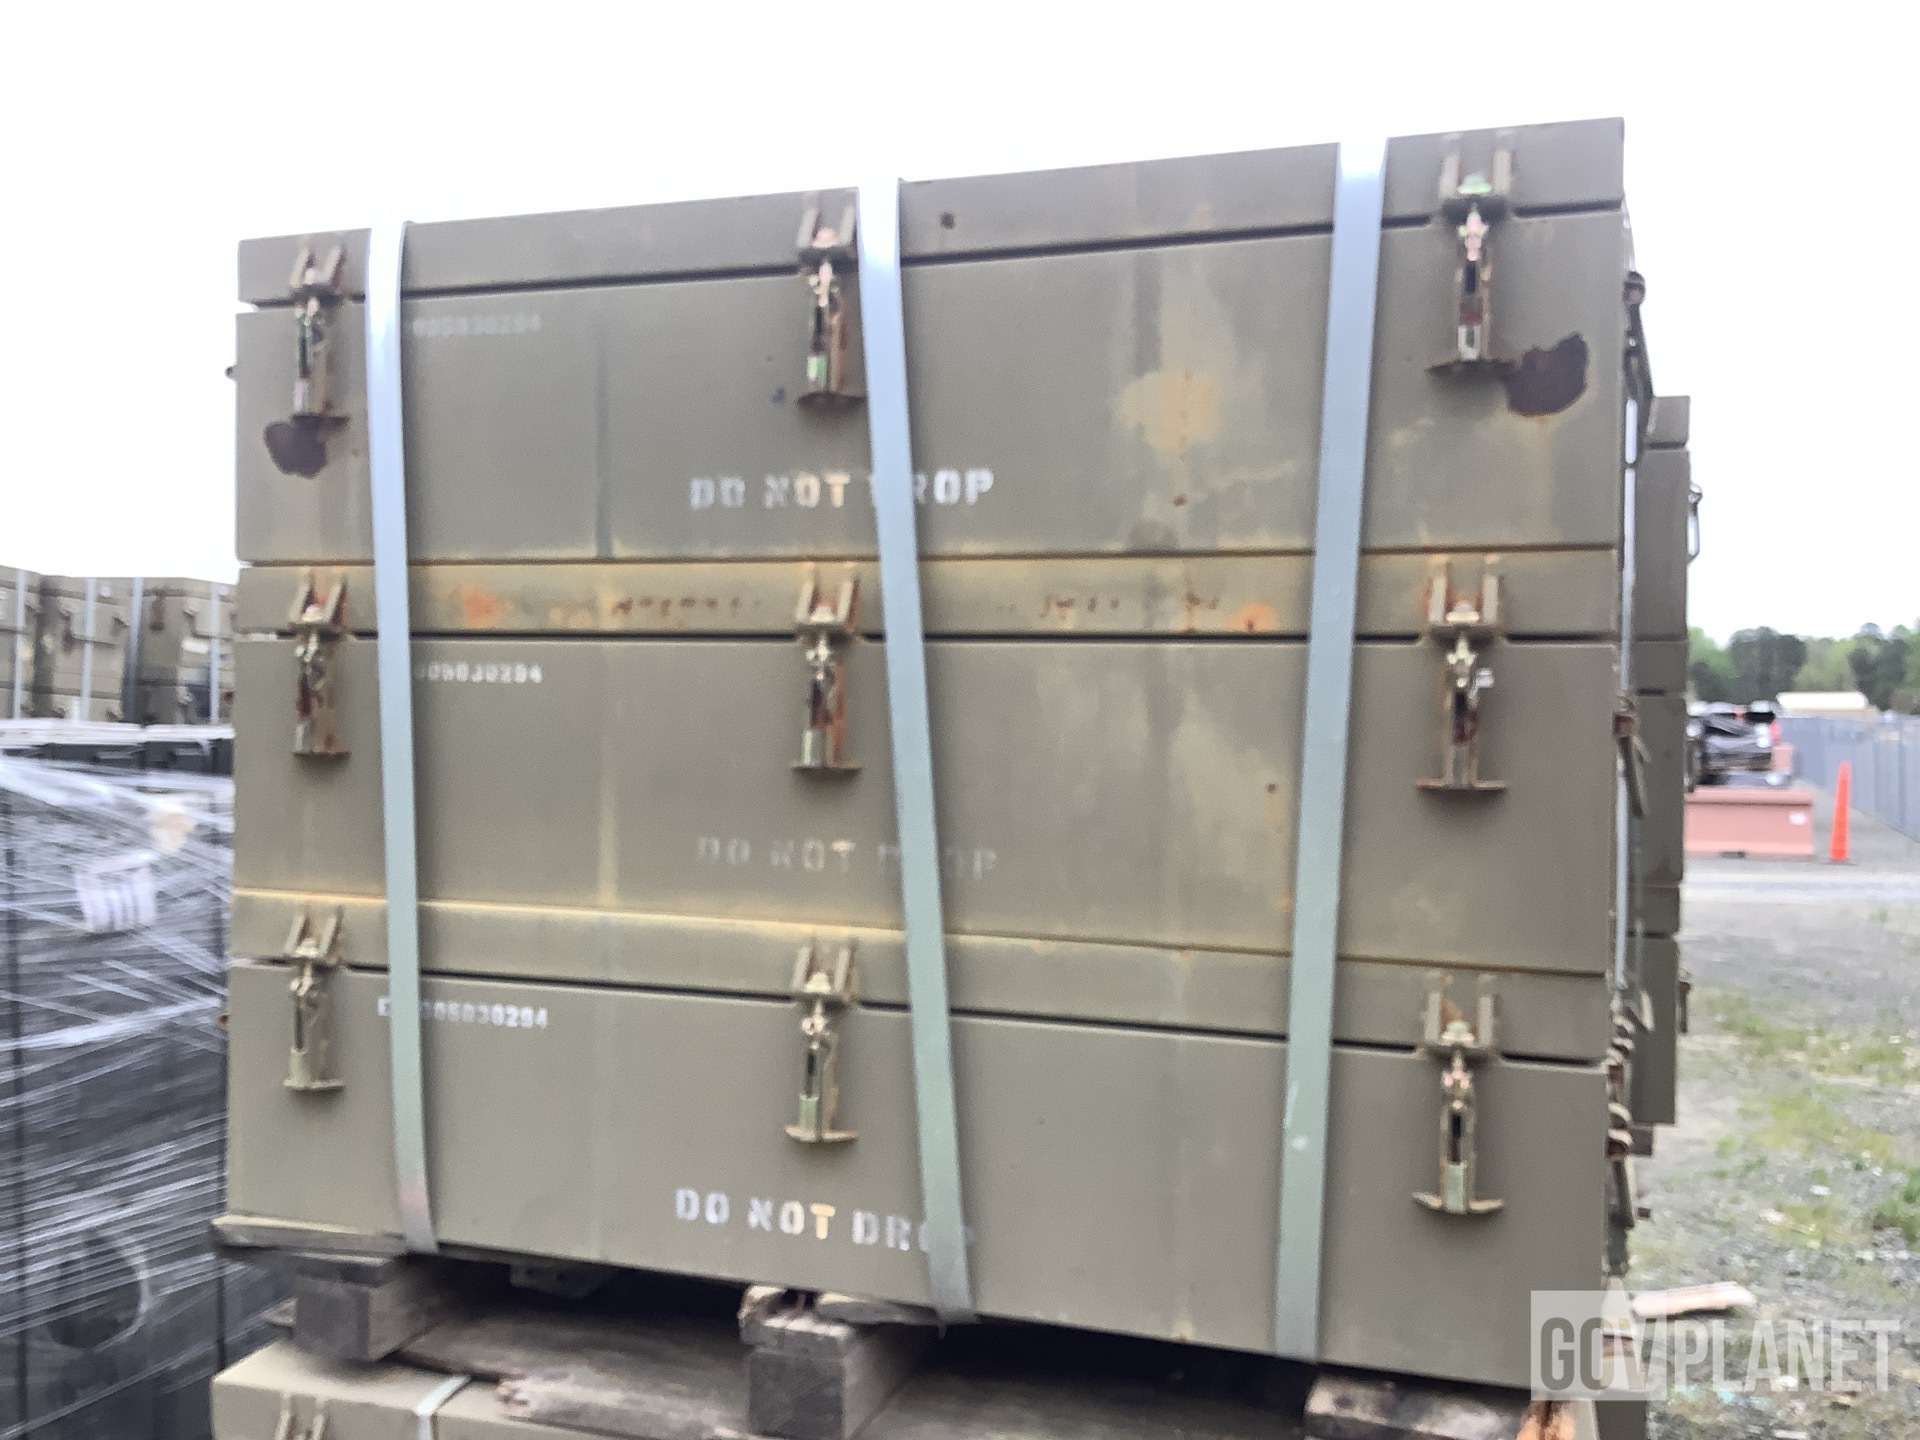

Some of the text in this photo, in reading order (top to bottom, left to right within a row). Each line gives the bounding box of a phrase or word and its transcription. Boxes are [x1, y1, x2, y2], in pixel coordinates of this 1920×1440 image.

[690, 474, 746, 509] DO
[764, 471, 850, 509] NOT
[675, 1187, 730, 1224] DO
[747, 1196, 836, 1240] NOT
